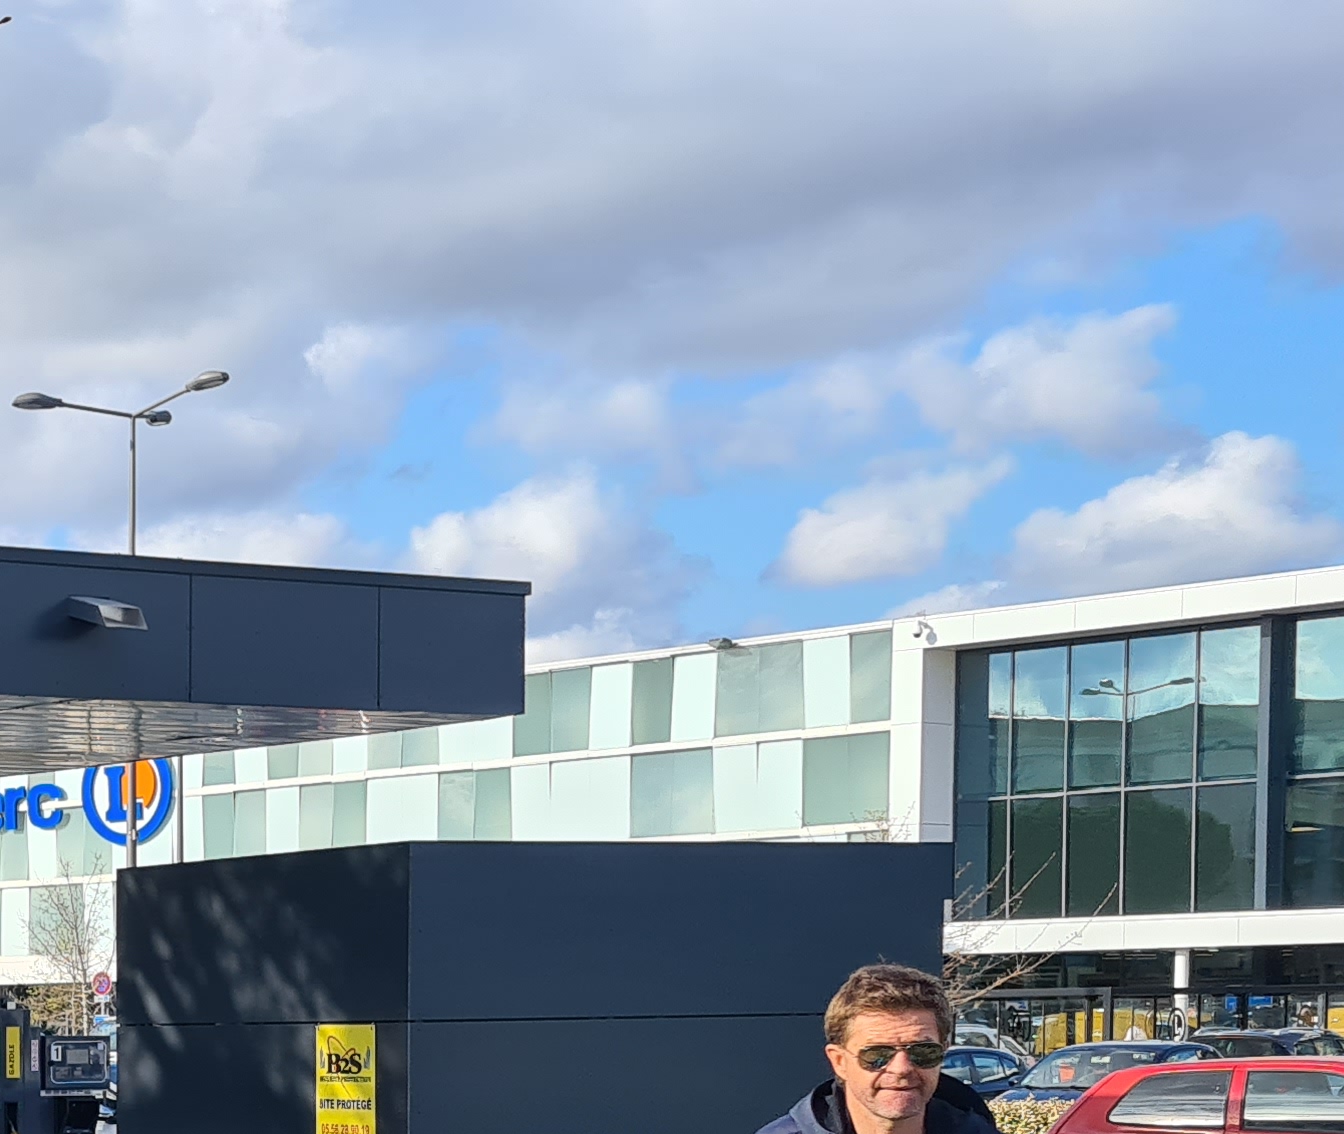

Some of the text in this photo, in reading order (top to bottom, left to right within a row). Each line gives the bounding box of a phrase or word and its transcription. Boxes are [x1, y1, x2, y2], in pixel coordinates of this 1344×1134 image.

[326, 1053, 362, 1075] B2S
[319, 1097, 372, 1111] SITE PROTÉGÉ
